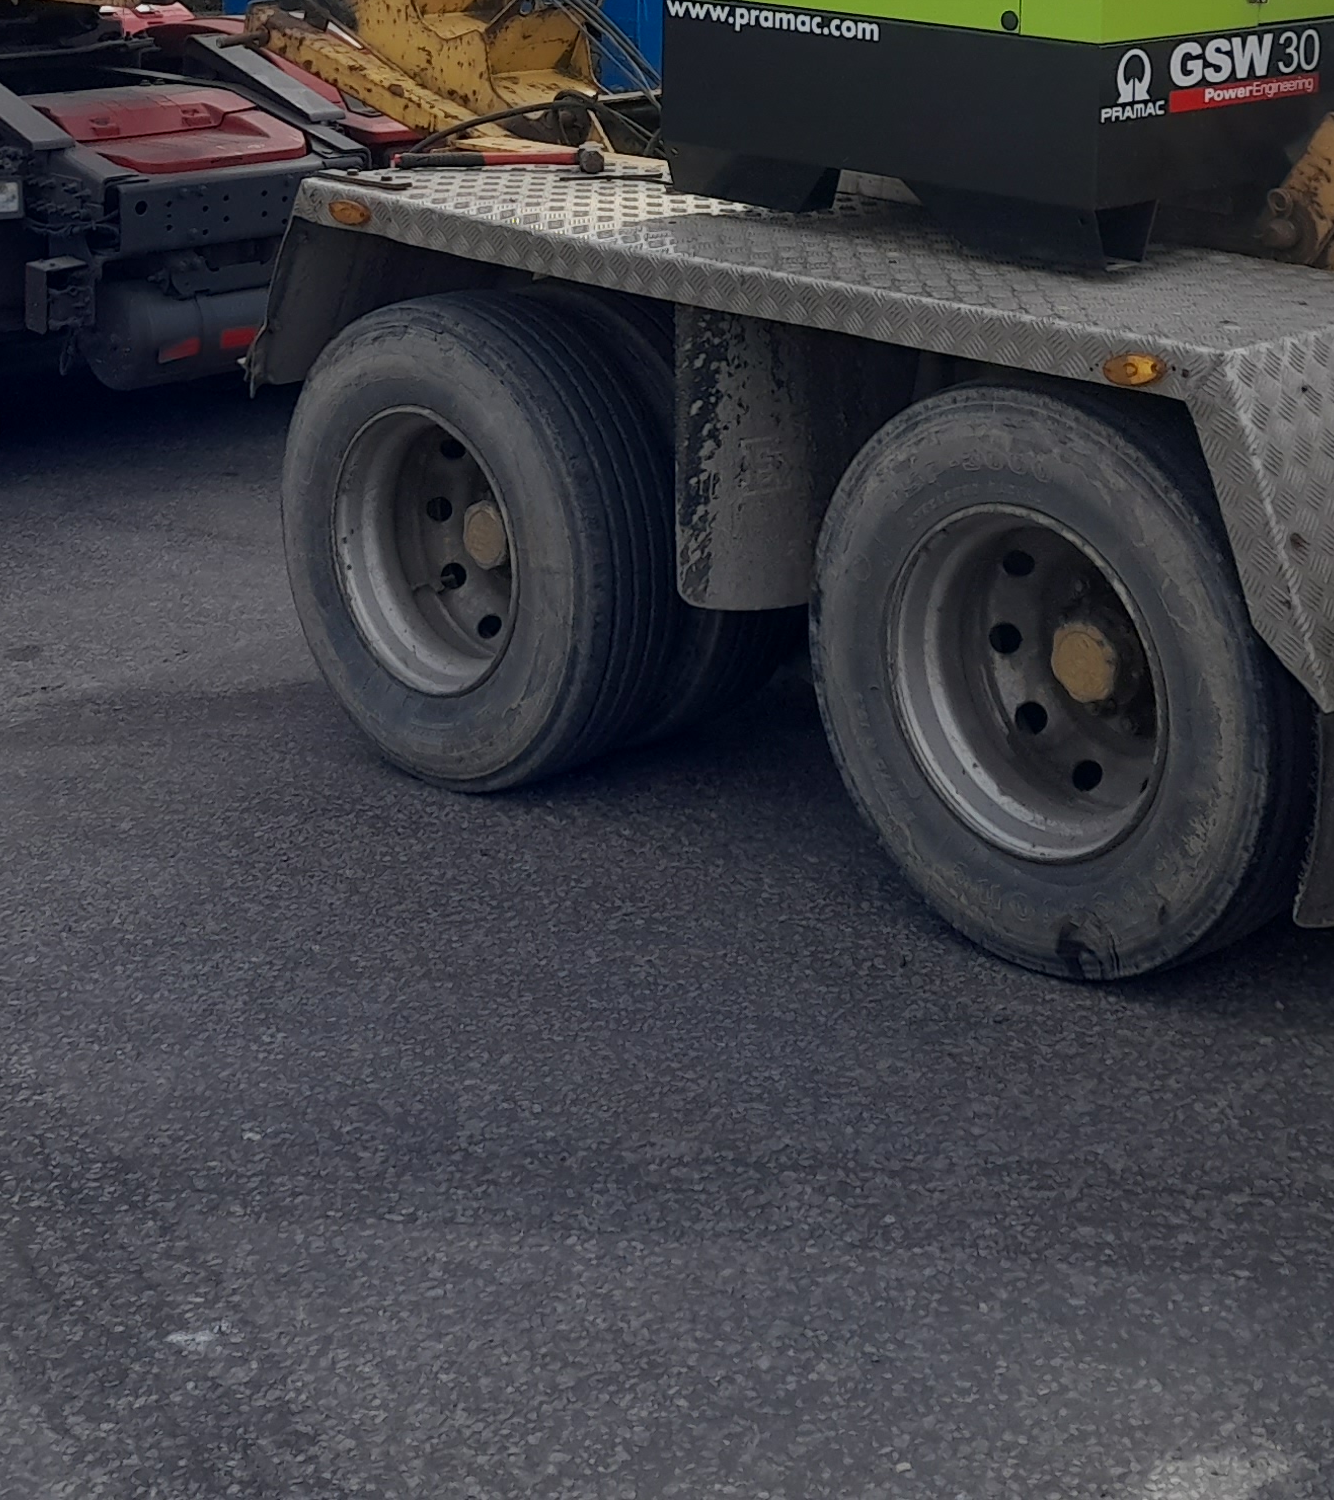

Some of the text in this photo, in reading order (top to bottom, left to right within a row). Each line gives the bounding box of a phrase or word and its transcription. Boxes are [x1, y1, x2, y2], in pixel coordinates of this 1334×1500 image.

[667, 0, 880, 42] www.pramac.com
[1169, 28, 1320, 88] GSW 30
[1204, 75, 1315, 103] PowerEngineering
[1100, 99, 1166, 124] PRAMAC
